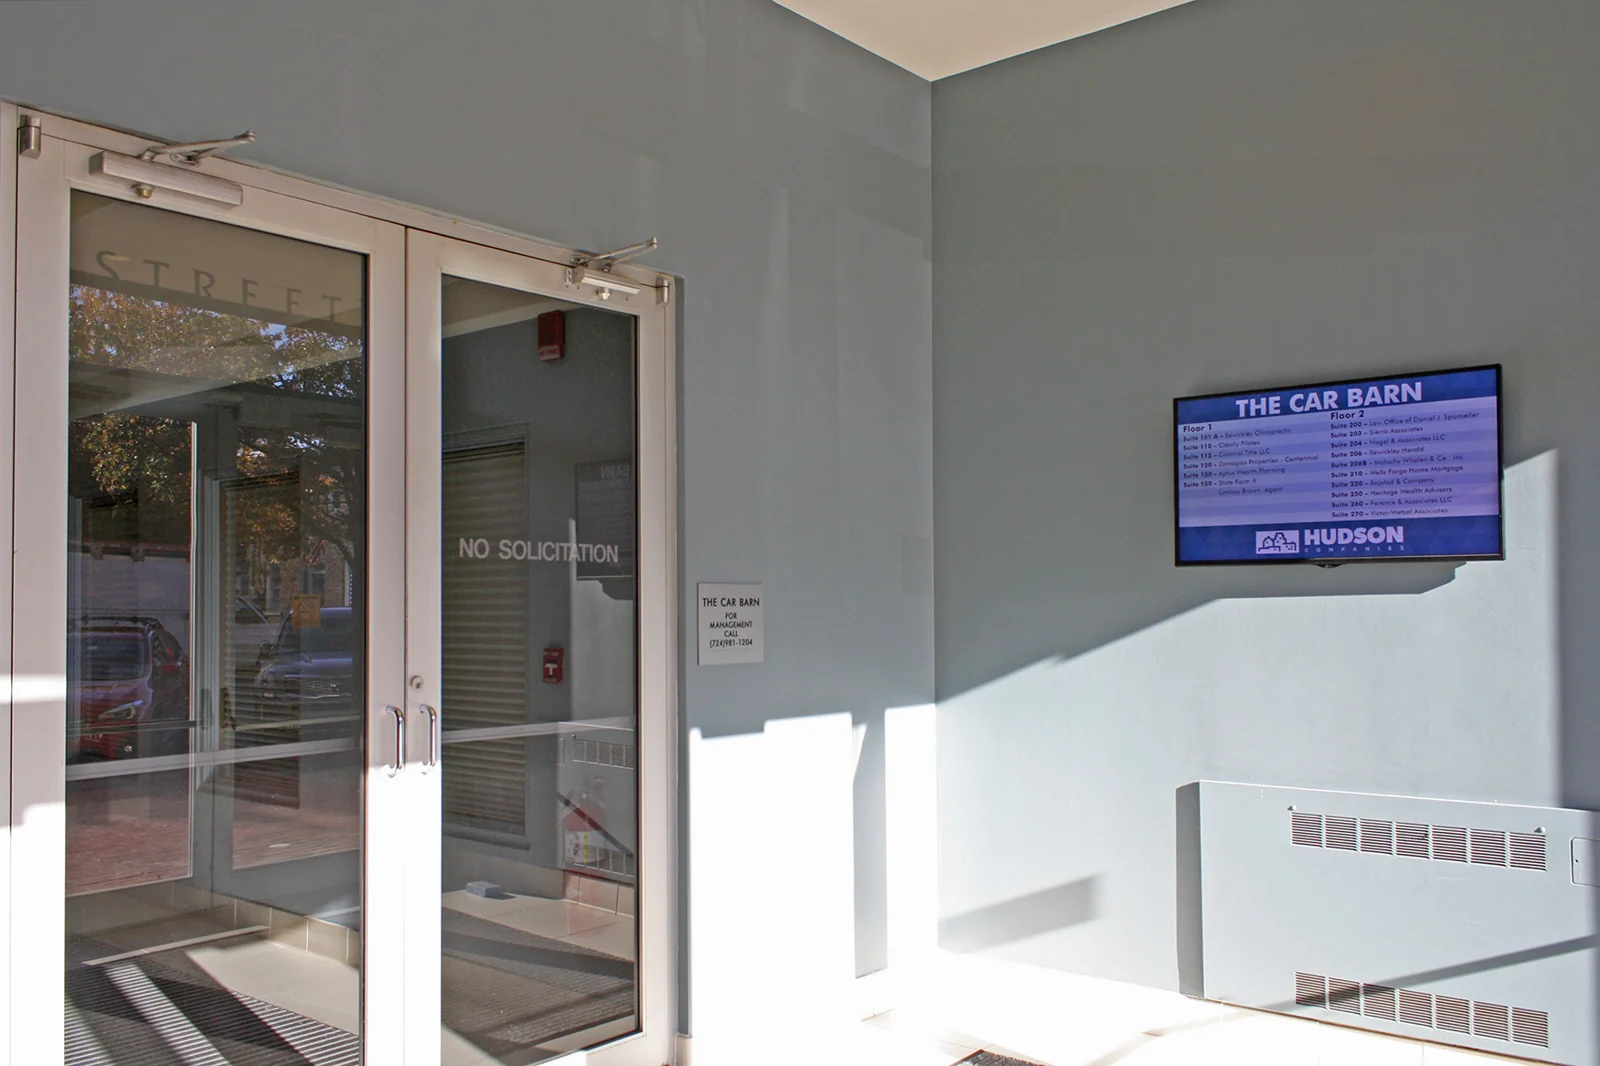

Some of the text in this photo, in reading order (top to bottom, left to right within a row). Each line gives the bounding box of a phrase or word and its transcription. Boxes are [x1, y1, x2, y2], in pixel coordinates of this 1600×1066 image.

[1235, 381, 1422, 418] THE CAR BARN
[1330, 410, 1365, 421] Floor 2
[1384, 417, 1403, 425] Office
[1443, 412, 1479, 420] Sponseller
[1183, 425, 1205, 433] Floor
[1390, 426, 1423, 434] Associates
[1397, 436, 1431, 444] Associates
[1259, 447, 1270, 455] LLC
[1248, 457, 1278, 466] Properties
[1284, 454, 1319, 463] Centennial
[1258, 467, 1286, 475] Planning
[1430, 465, 1463, 473] Mortgage
[1402, 477, 1435, 485] Company
[1264, 486, 1283, 494] Agent
[1404, 497, 1438, 505] Associates
[1304, 525, 1404, 546] HUDSON
[459, 538, 490, 559] NO
[498, 539, 620, 564] SOLICITATION
[702, 597, 760, 607] THE CAR BARN
[725, 612, 737, 620] FOR
[709, 621, 753, 629] MANAGEMENT
[723, 629, 739, 638] CALL
[709, 638, 753, 649] (724)981-1204
